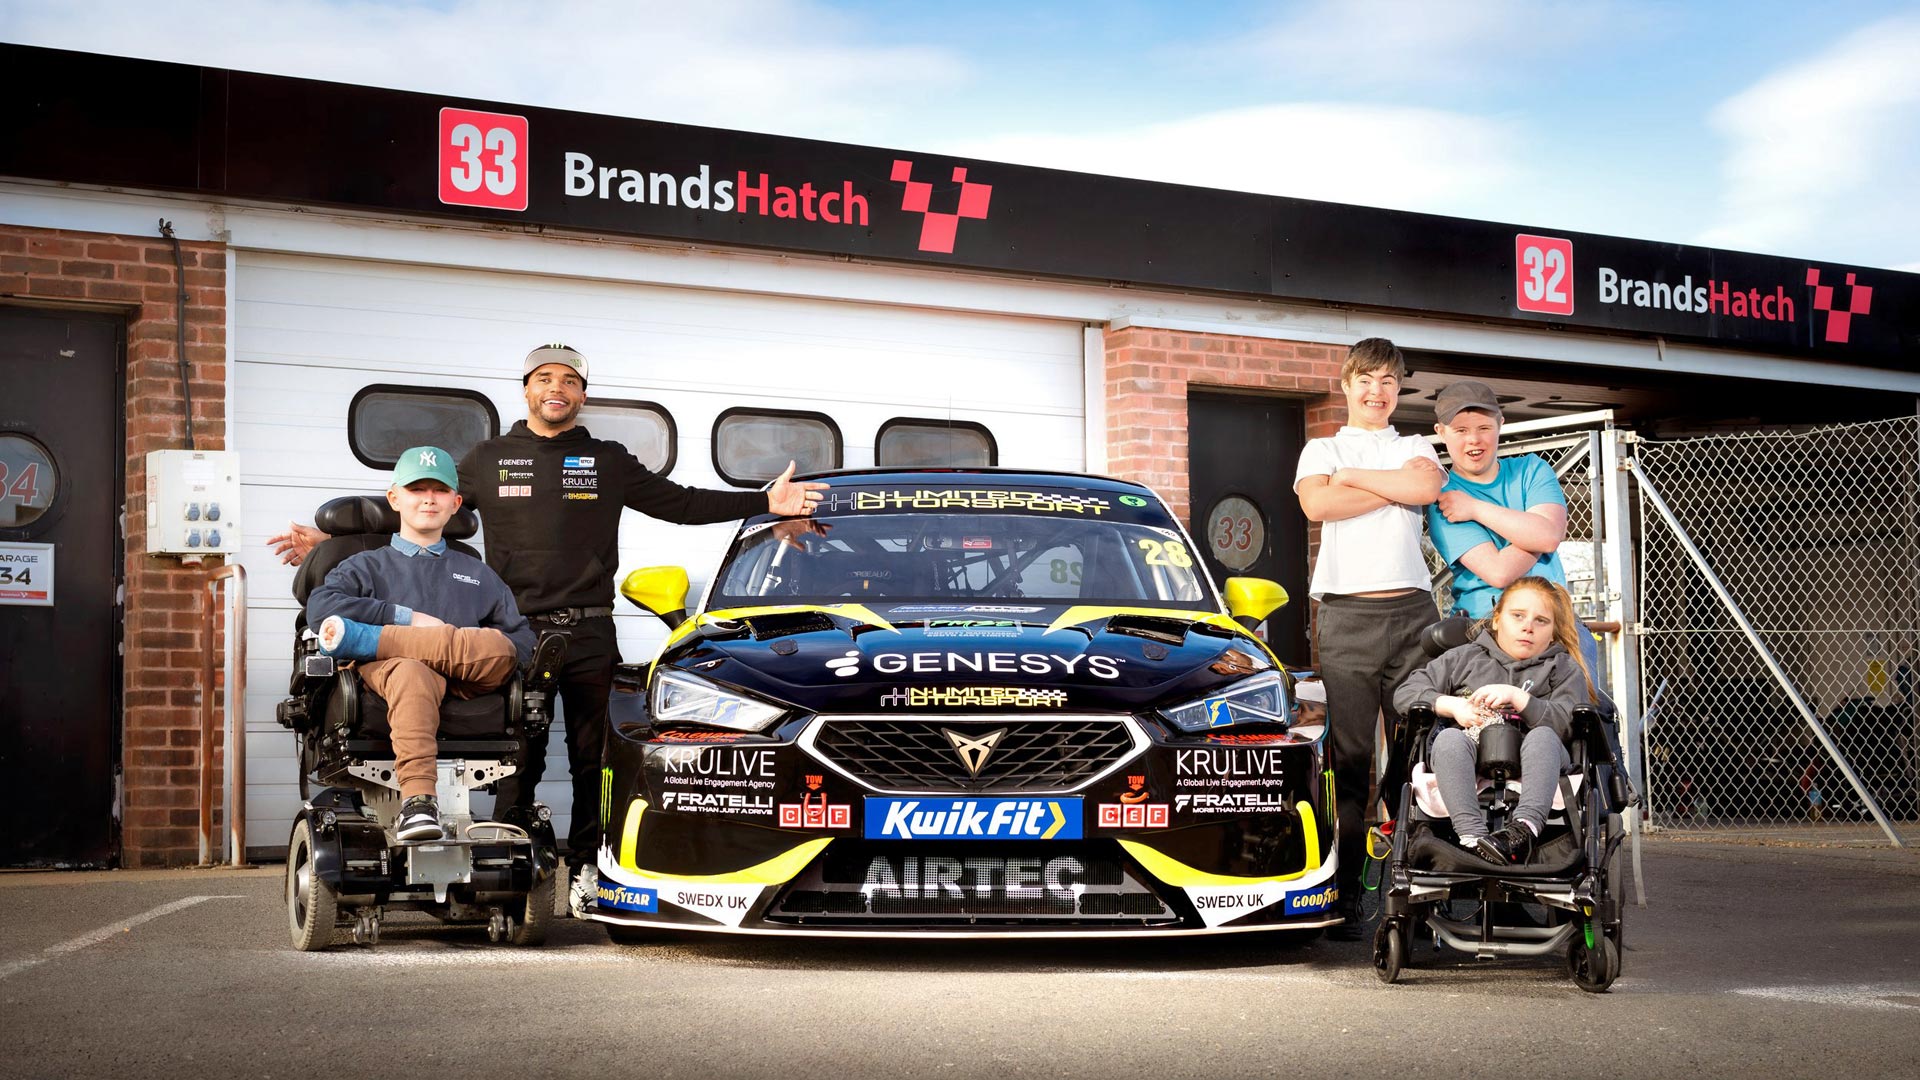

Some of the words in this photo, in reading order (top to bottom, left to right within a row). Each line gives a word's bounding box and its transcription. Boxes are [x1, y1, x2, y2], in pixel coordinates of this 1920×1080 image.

[450, 123, 517, 196] 33
[564, 151, 869, 226] BrandsHatch
[1523, 246, 1567, 304] 32
[1598, 267, 1795, 322] BrandsHatch
[562, 477, 598, 486] KRULIVE
[1216, 516, 1253, 552] 33
[0, 555, 38, 563] ARAGE
[1138, 538, 1193, 568] 28
[664, 748, 776, 777] KRULIVE
[1176, 749, 1284, 775] KRULIVE
[664, 776, 669, 784] A
[669, 776, 689, 785] Global
[689, 777, 703, 785] Live
[704, 777, 747, 788] Engagement
[748, 780, 776, 789] Agency
[805, 775, 823, 784] TOW
[1127, 775, 1145, 785] TOW
[1183, 778, 1205, 787] Global
[1221, 778, 1262, 788] Engagement
[1262, 778, 1284, 788] Agency
[677, 793, 773, 809] FRATELLI
[1192, 793, 1282, 807] FRATELLI
[860, 856, 1086, 900] AIRTEC
[677, 891, 724, 908] SWEDX
[728, 895, 748, 910] UK
[1196, 894, 1244, 909] SWEDX
[1247, 893, 1264, 907] UK
